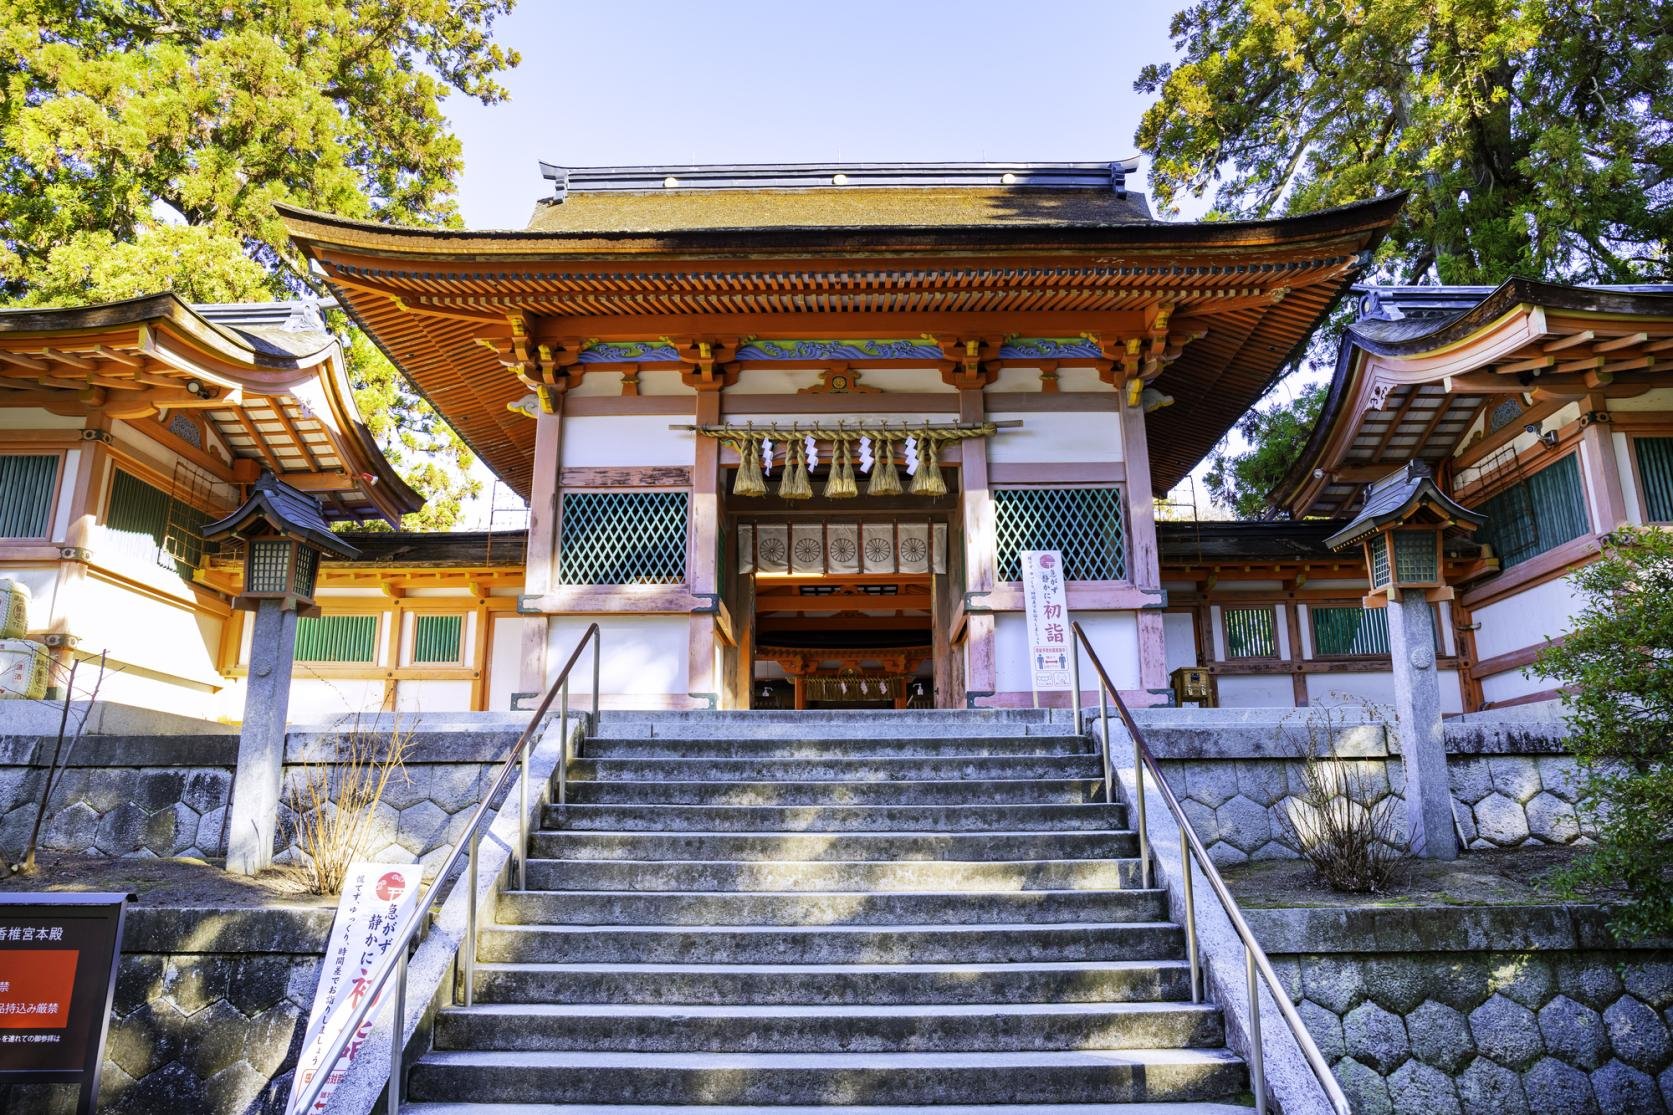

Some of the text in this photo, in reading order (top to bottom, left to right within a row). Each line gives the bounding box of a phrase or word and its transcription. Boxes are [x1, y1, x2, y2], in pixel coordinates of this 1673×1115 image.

[1043, 600, 1064, 643] 初詣
[0, 926, 64, 941] 香椎宮本殿
[360, 913, 383, 965] 静かに
[378, 903, 398, 956] 急がず
[0, 1035, 61, 1043] を連れての御参拝は
